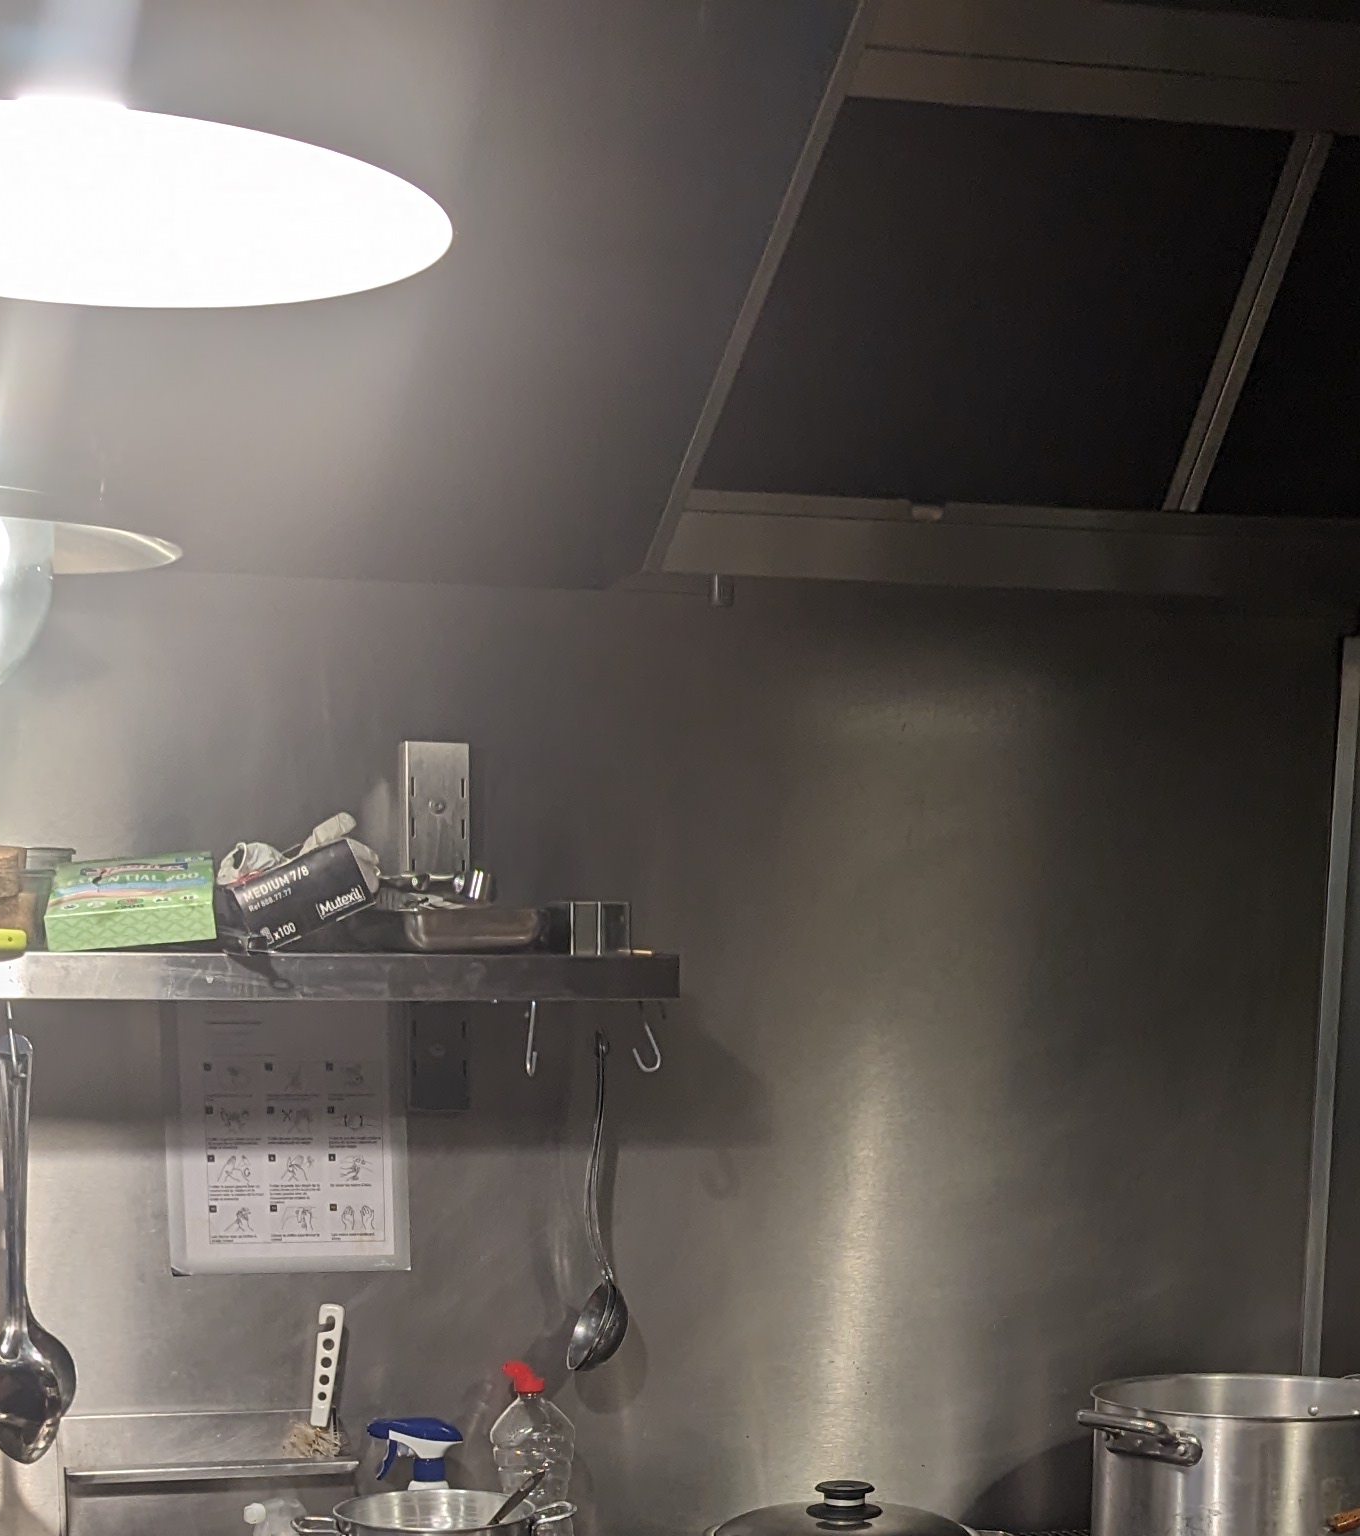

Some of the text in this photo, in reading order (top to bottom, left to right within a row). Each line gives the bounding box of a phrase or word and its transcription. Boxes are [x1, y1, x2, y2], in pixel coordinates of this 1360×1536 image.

[242, 865, 310, 902] MEDIUM 7/8
[248, 902, 261, 912] Ref
[320, 887, 362, 916] Mutexil
[273, 921, 297, 941] x100
